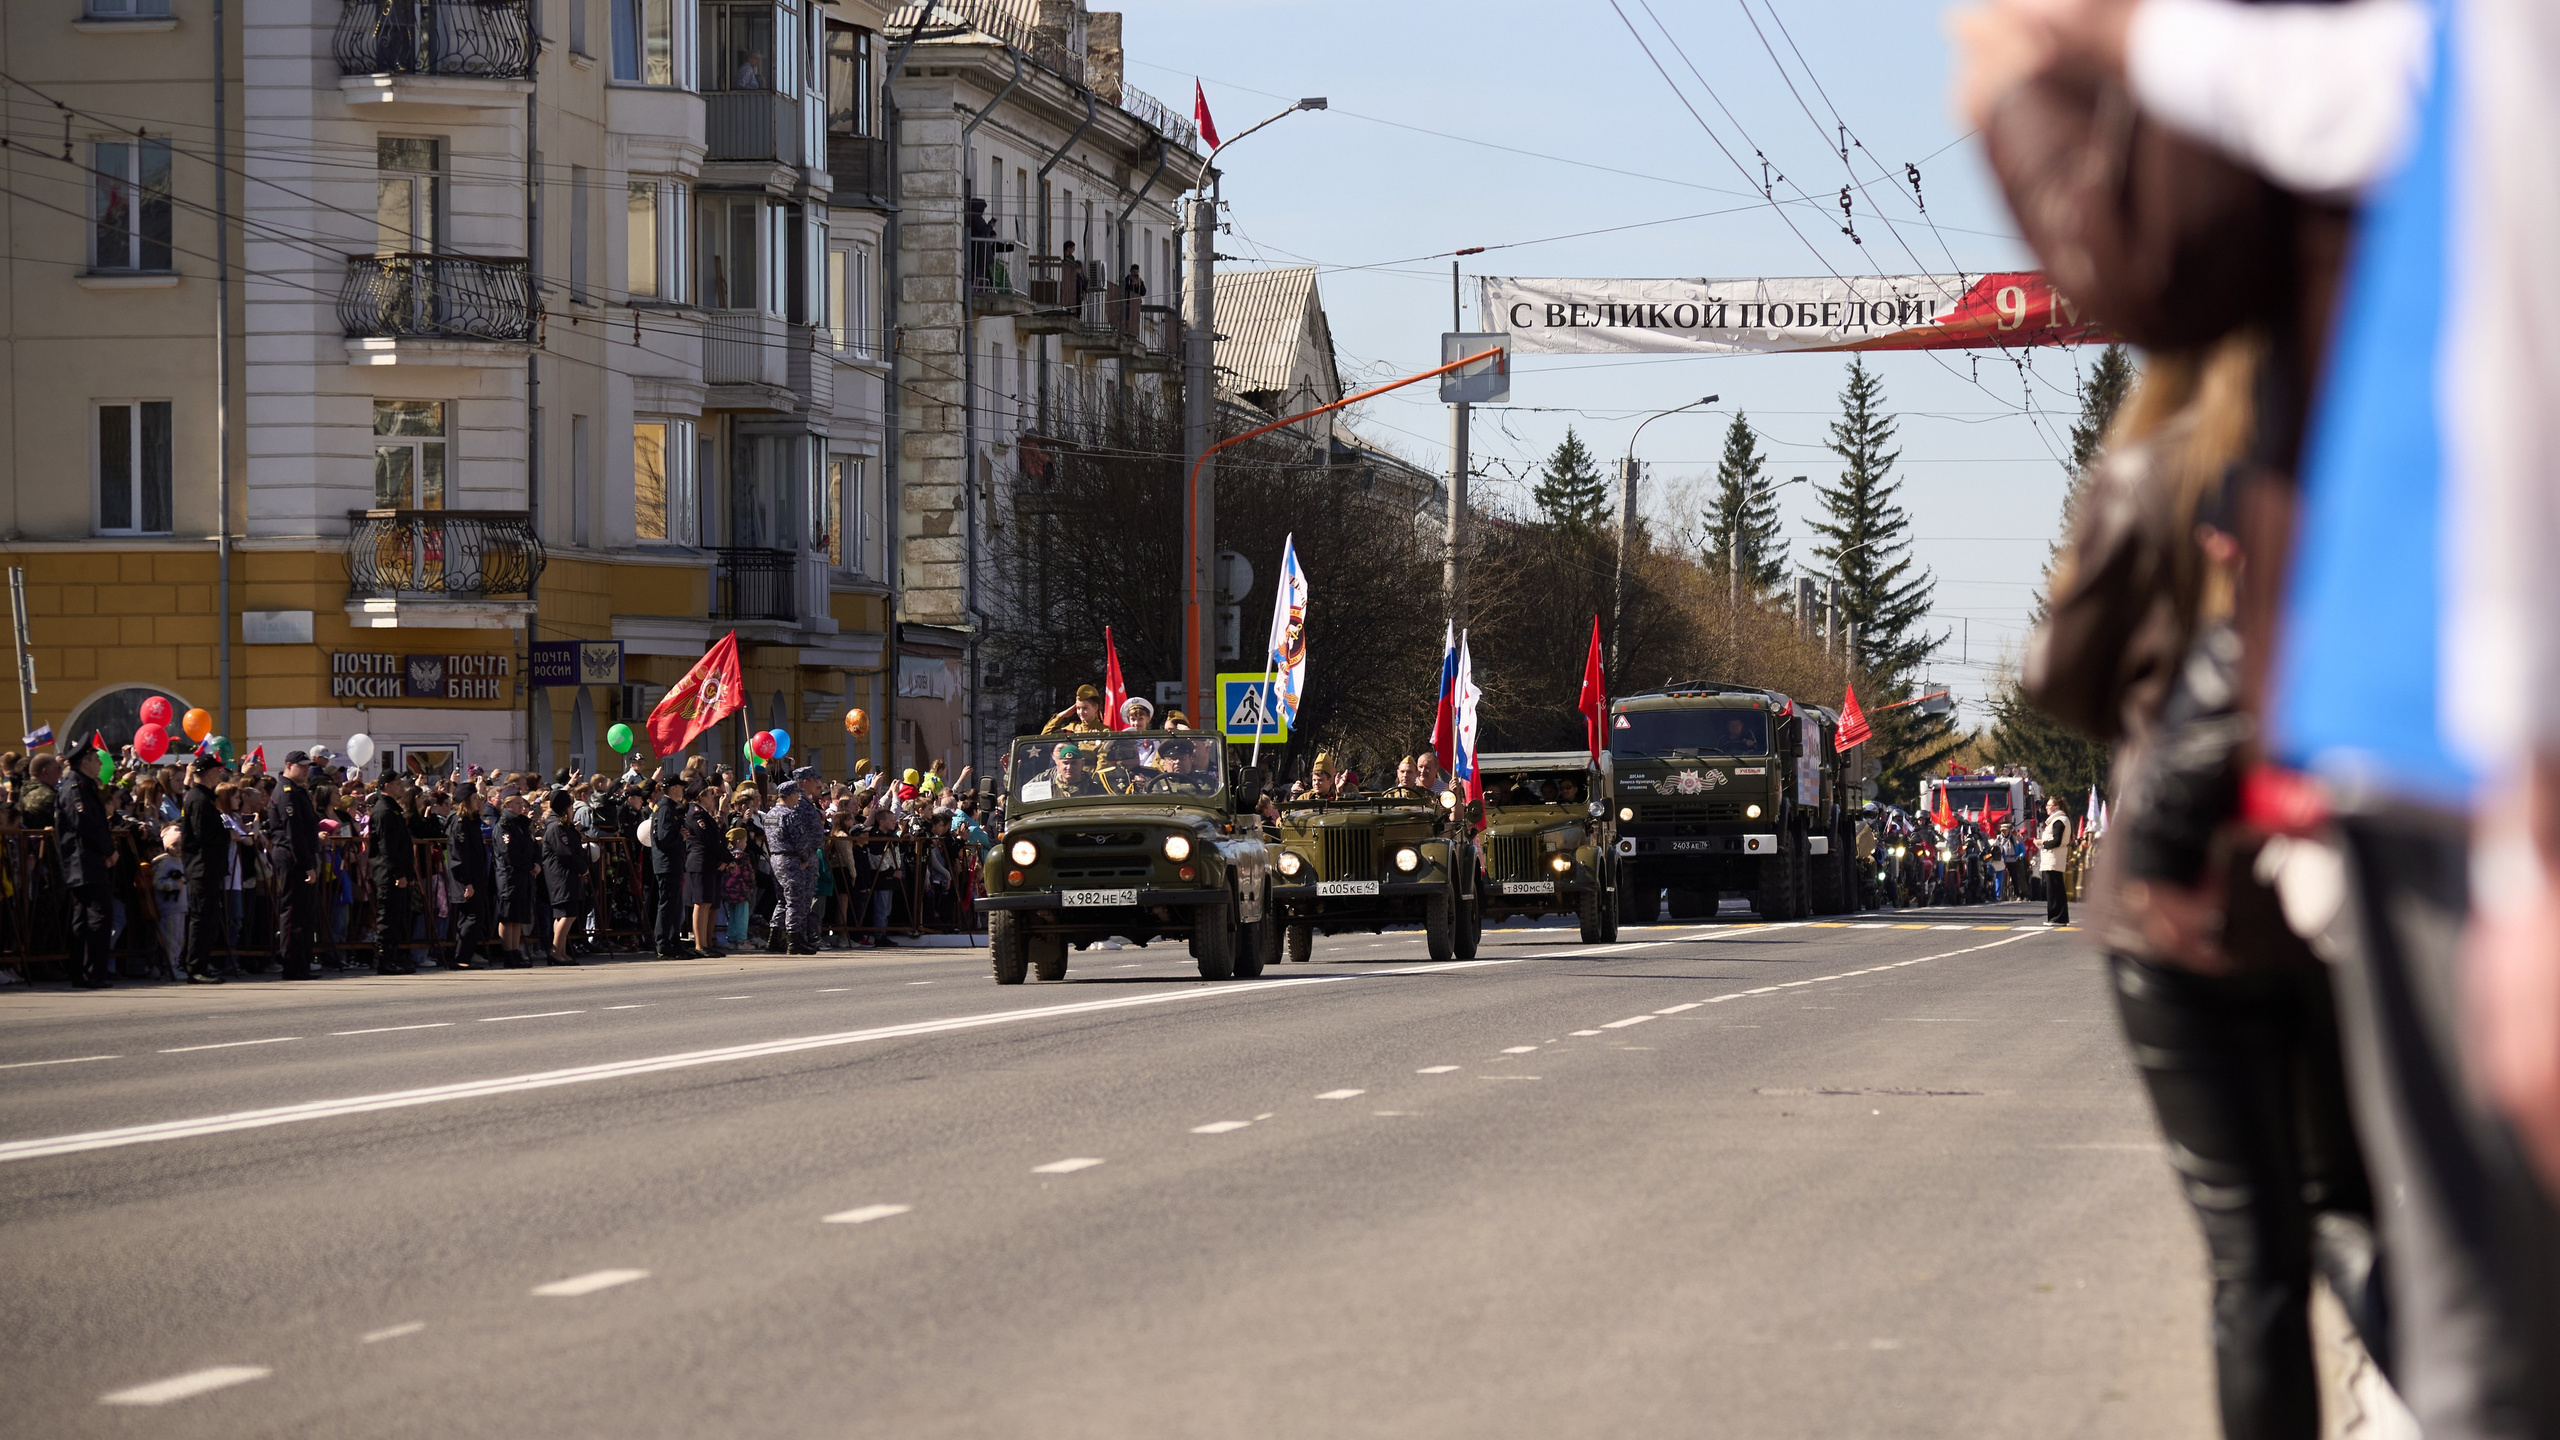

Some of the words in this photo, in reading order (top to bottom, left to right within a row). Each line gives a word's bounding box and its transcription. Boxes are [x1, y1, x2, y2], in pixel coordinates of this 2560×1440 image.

[1510, 303, 1533, 328] С
[1544, 297, 1728, 329] ВЕЛИКОЙ
[1738, 294, 1936, 334] ПОБЕДОЙ!
[1996, 286, 2026, 331] 9
[333, 652, 396, 674] ПОЧТА
[448, 655, 509, 676] ПОЧТА
[534, 651, 571, 663] ПОЧТА
[534, 665, 572, 677] РОССИИ
[333, 677, 400, 698] РОССИИ
[449, 679, 501, 699] БАНК
